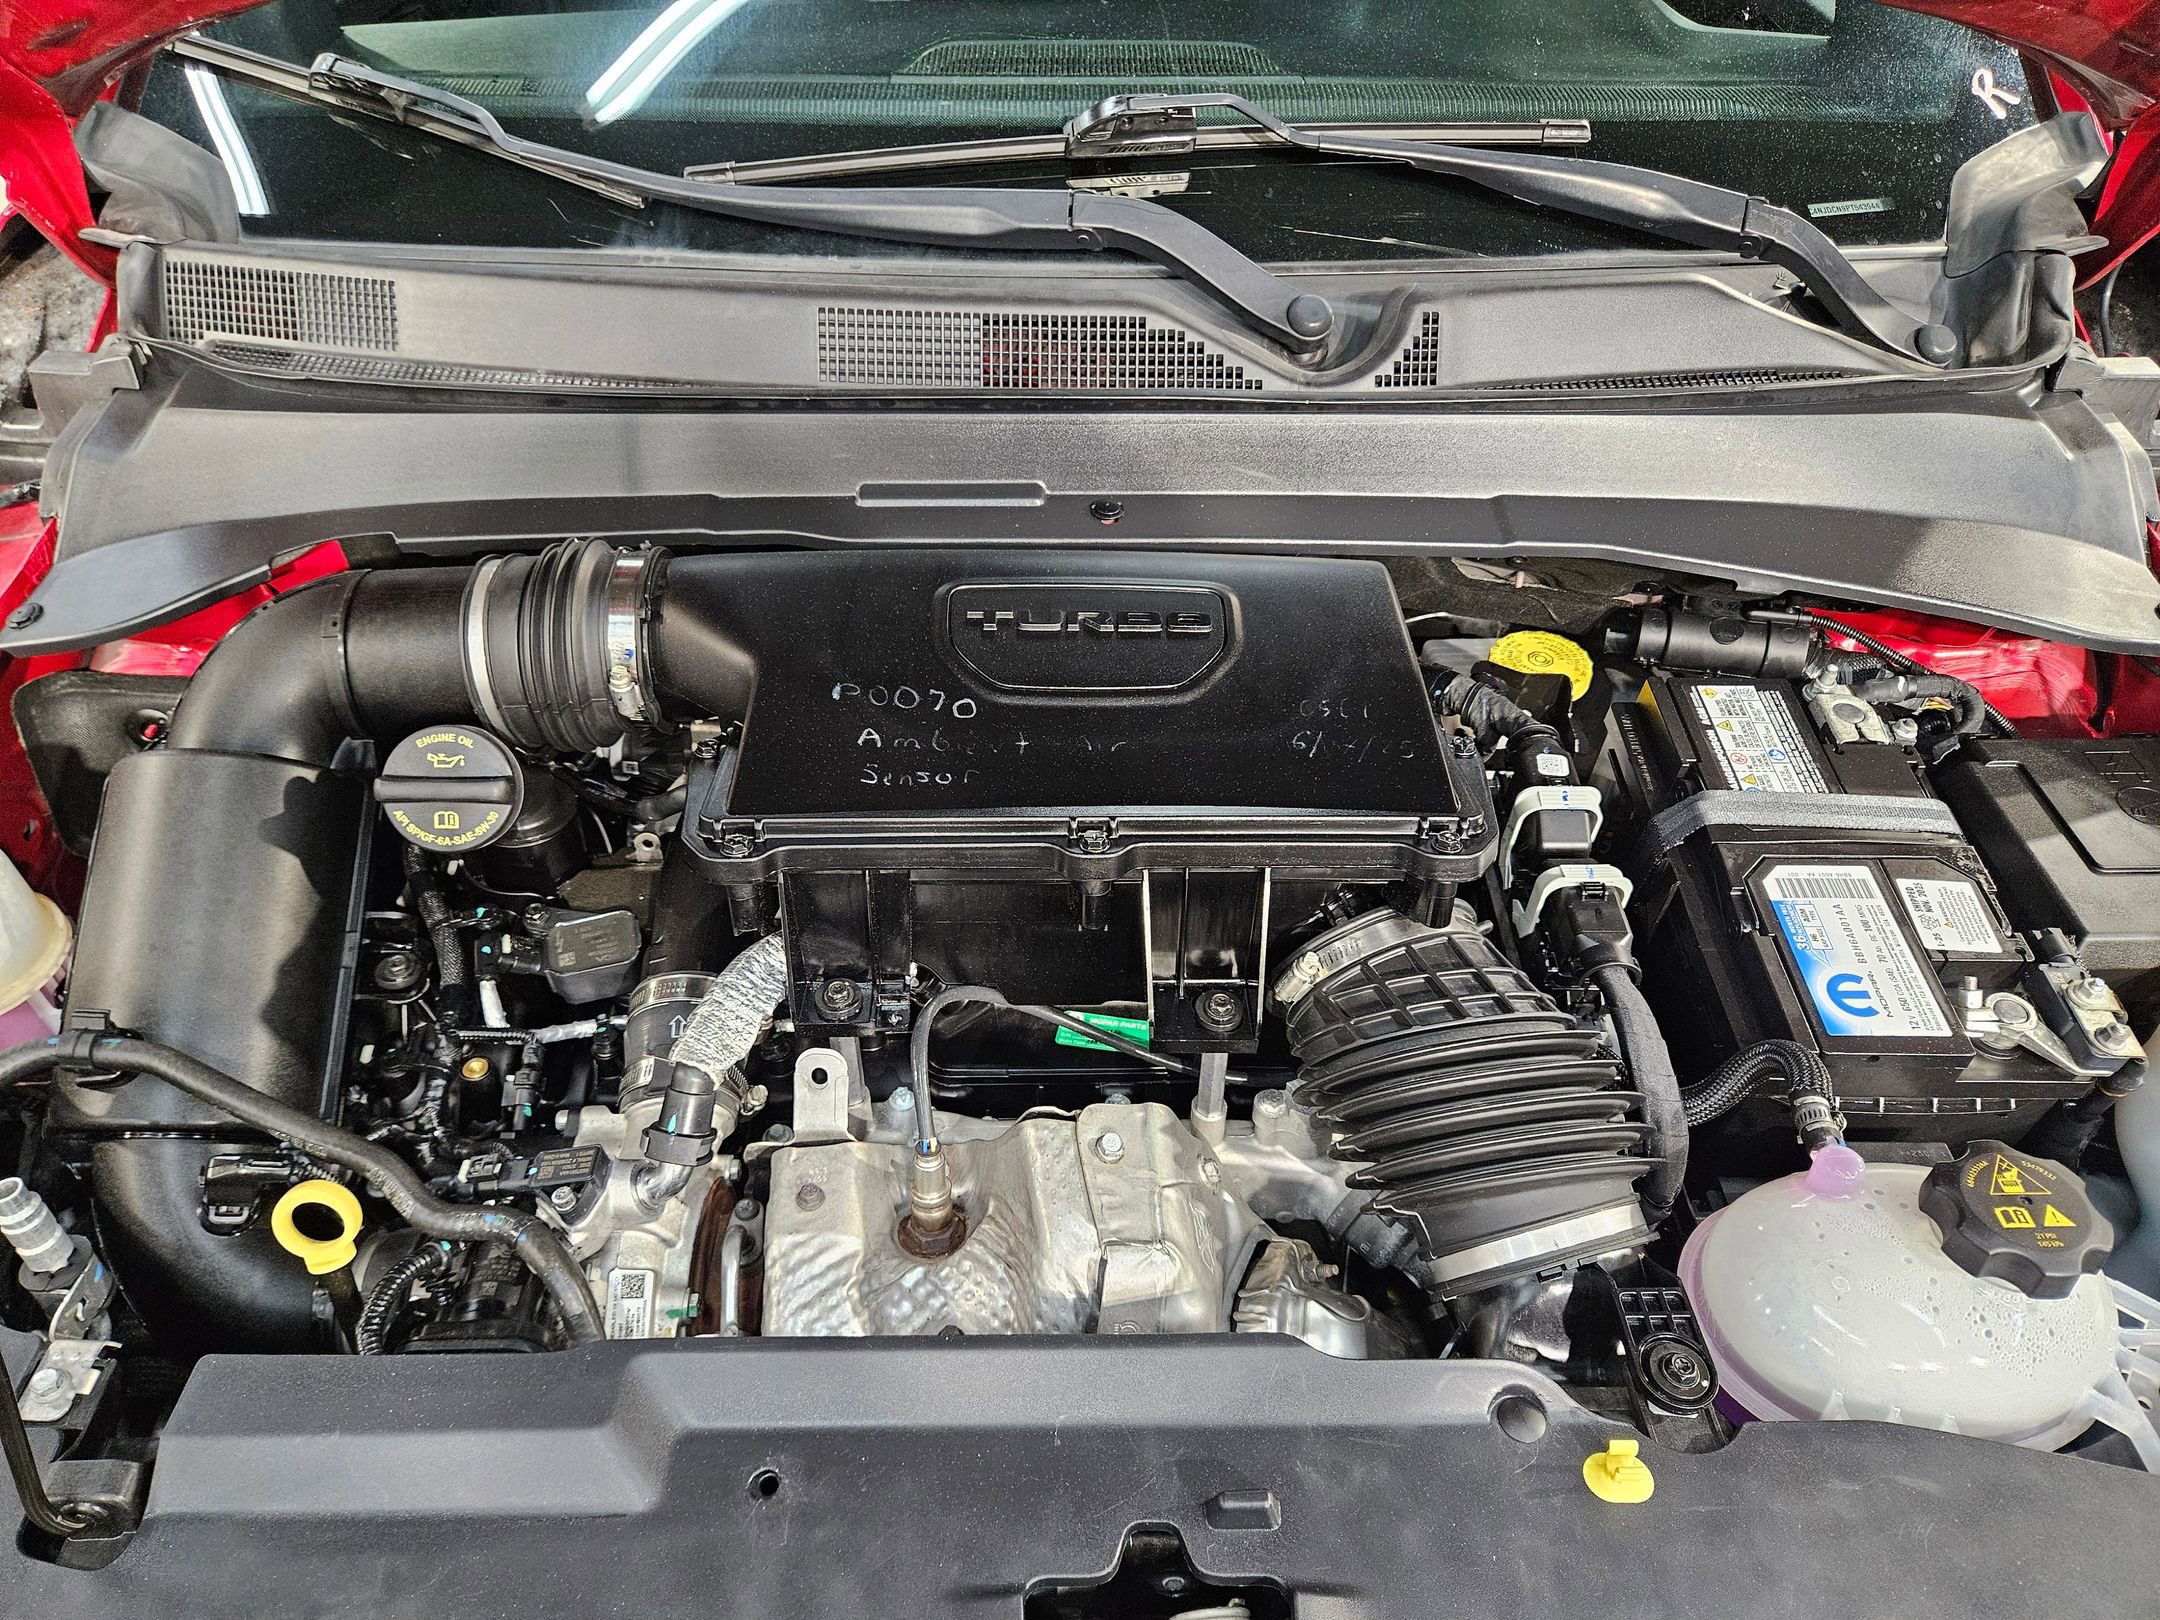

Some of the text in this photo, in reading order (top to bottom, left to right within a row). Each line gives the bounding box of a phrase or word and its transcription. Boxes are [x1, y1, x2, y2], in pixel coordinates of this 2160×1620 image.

[1972, 68, 2020, 119] R
[966, 610, 1213, 632] TURBO
[415, 732, 475, 749] ENGINE OIL
[857, 727, 1030, 755] Ambt
[860, 763, 980, 786] Sensor
[393, 810, 410, 827] API
[1904, 886, 1924, 912] SHIPPED
[1793, 936, 1811, 951] 36
